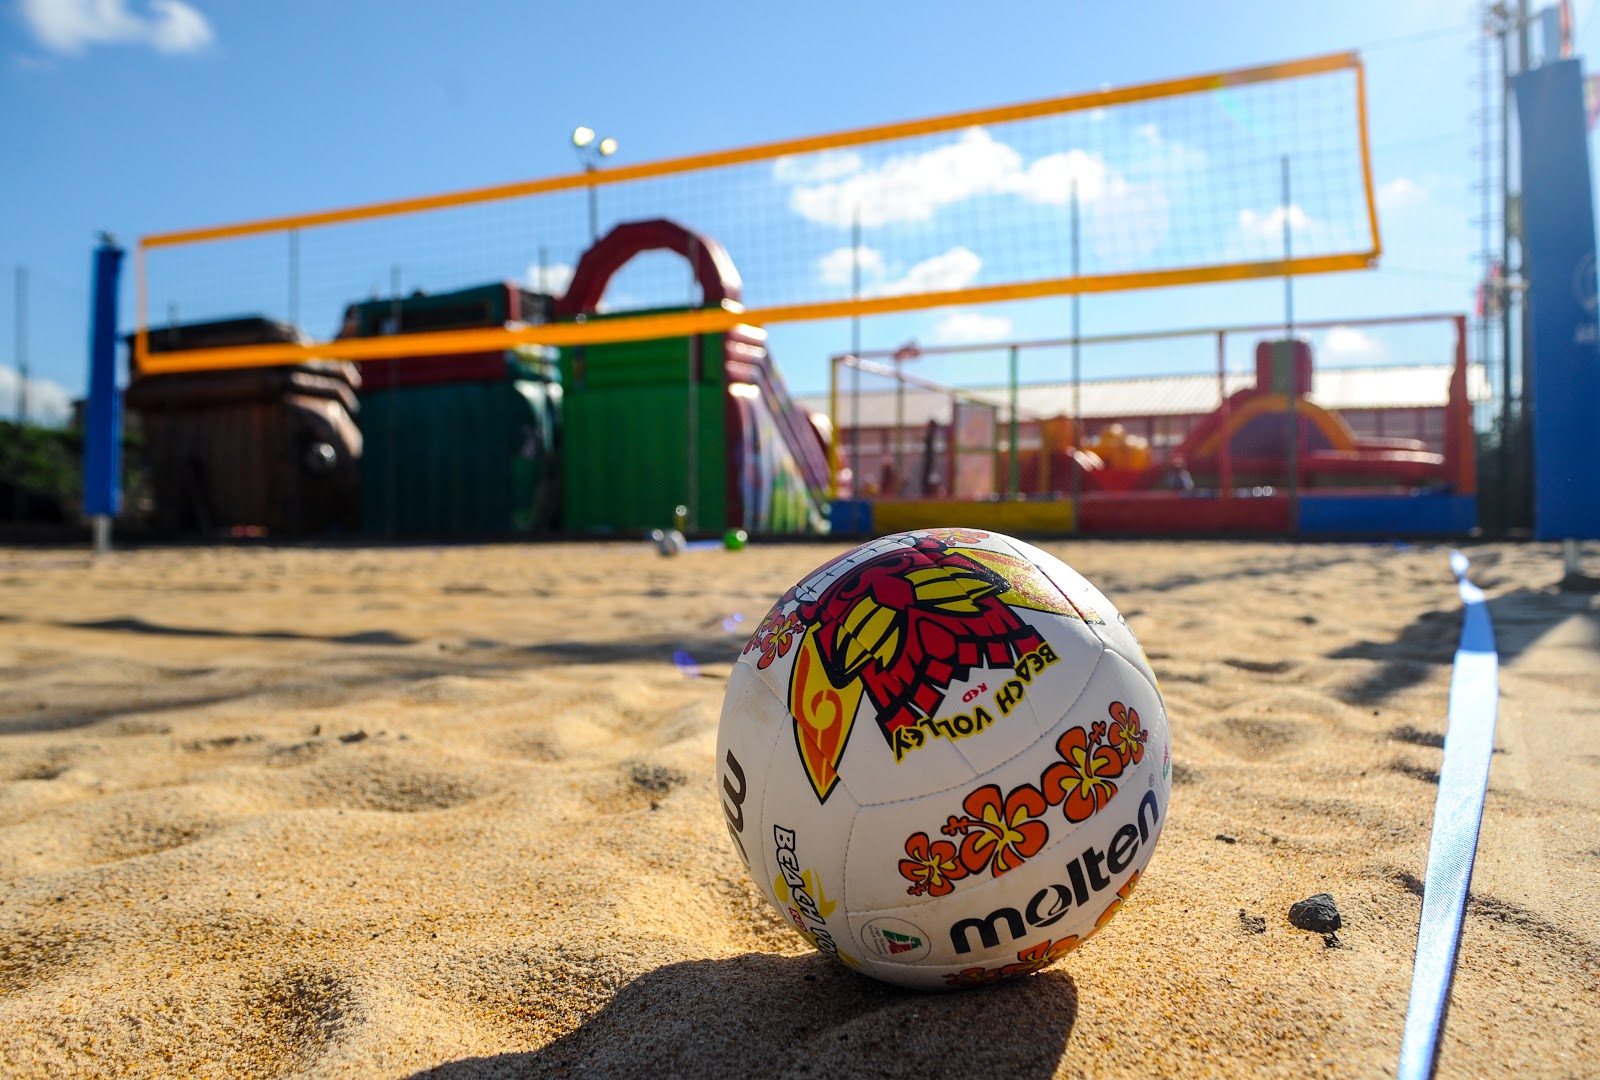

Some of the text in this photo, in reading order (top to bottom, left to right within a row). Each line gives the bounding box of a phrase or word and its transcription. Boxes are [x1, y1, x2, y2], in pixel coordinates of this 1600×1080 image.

[893, 642, 1060, 764] BEACH VOLLEY
[962, 682, 989, 704] RED
[773, 824, 826, 926] BEACH
[950, 789, 1160, 955] molten
